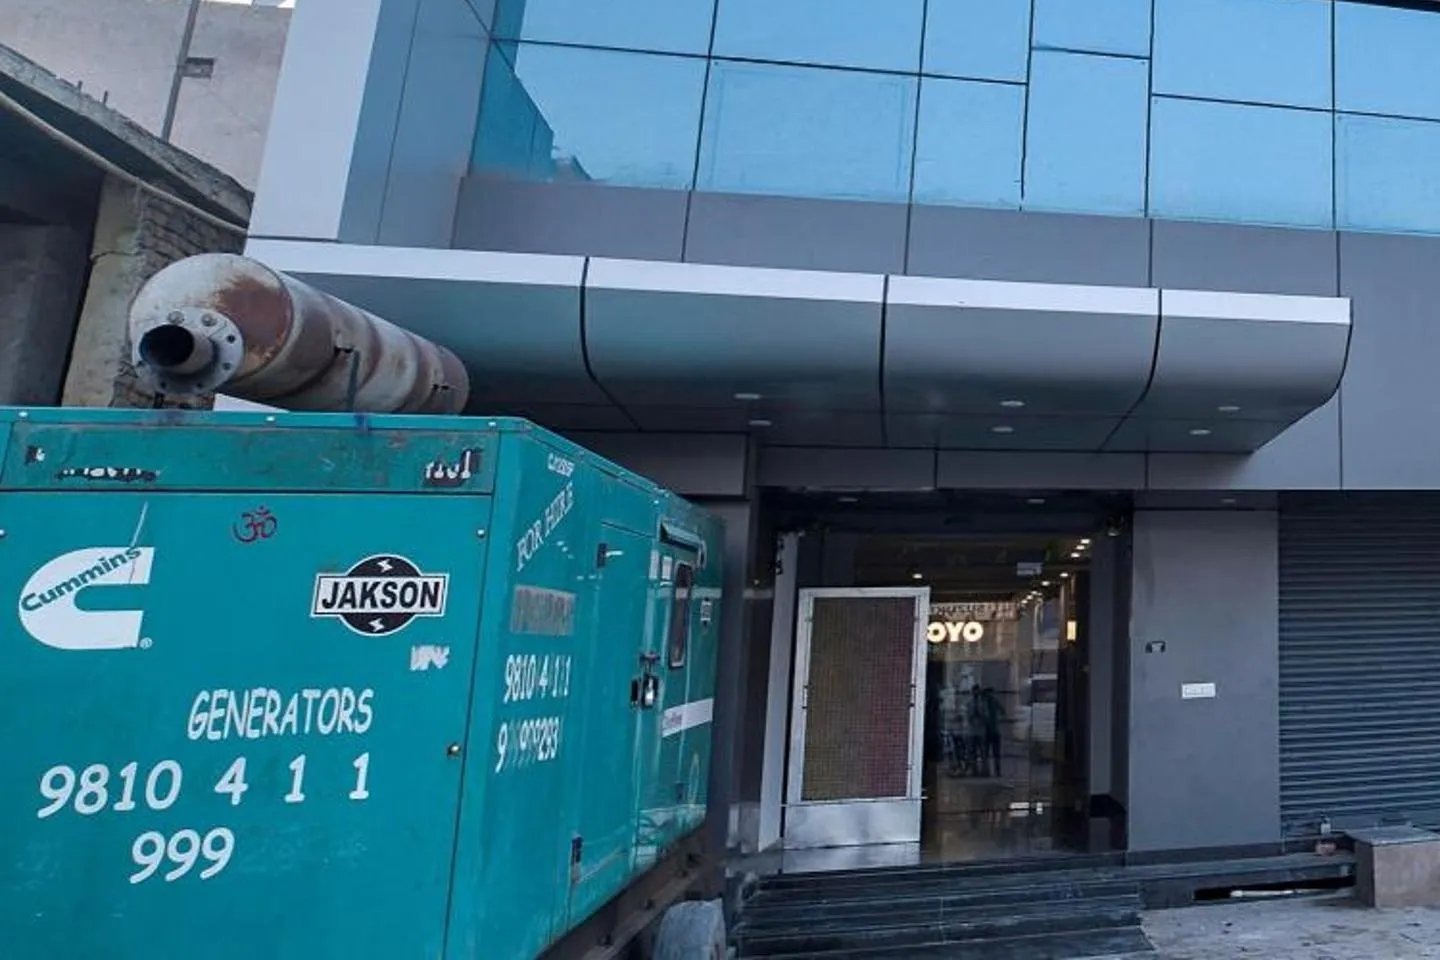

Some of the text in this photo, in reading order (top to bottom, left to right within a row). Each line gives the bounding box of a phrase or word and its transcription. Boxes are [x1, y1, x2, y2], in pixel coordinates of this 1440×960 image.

[21, 547, 142, 612] Cummins
[321, 580, 441, 610] JAKSON
[926, 621, 984, 643] OYO
[187, 687, 374, 741] GENERATORS
[37, 752, 370, 819] 9810 4 1 1
[129, 826, 236, 884] 999
